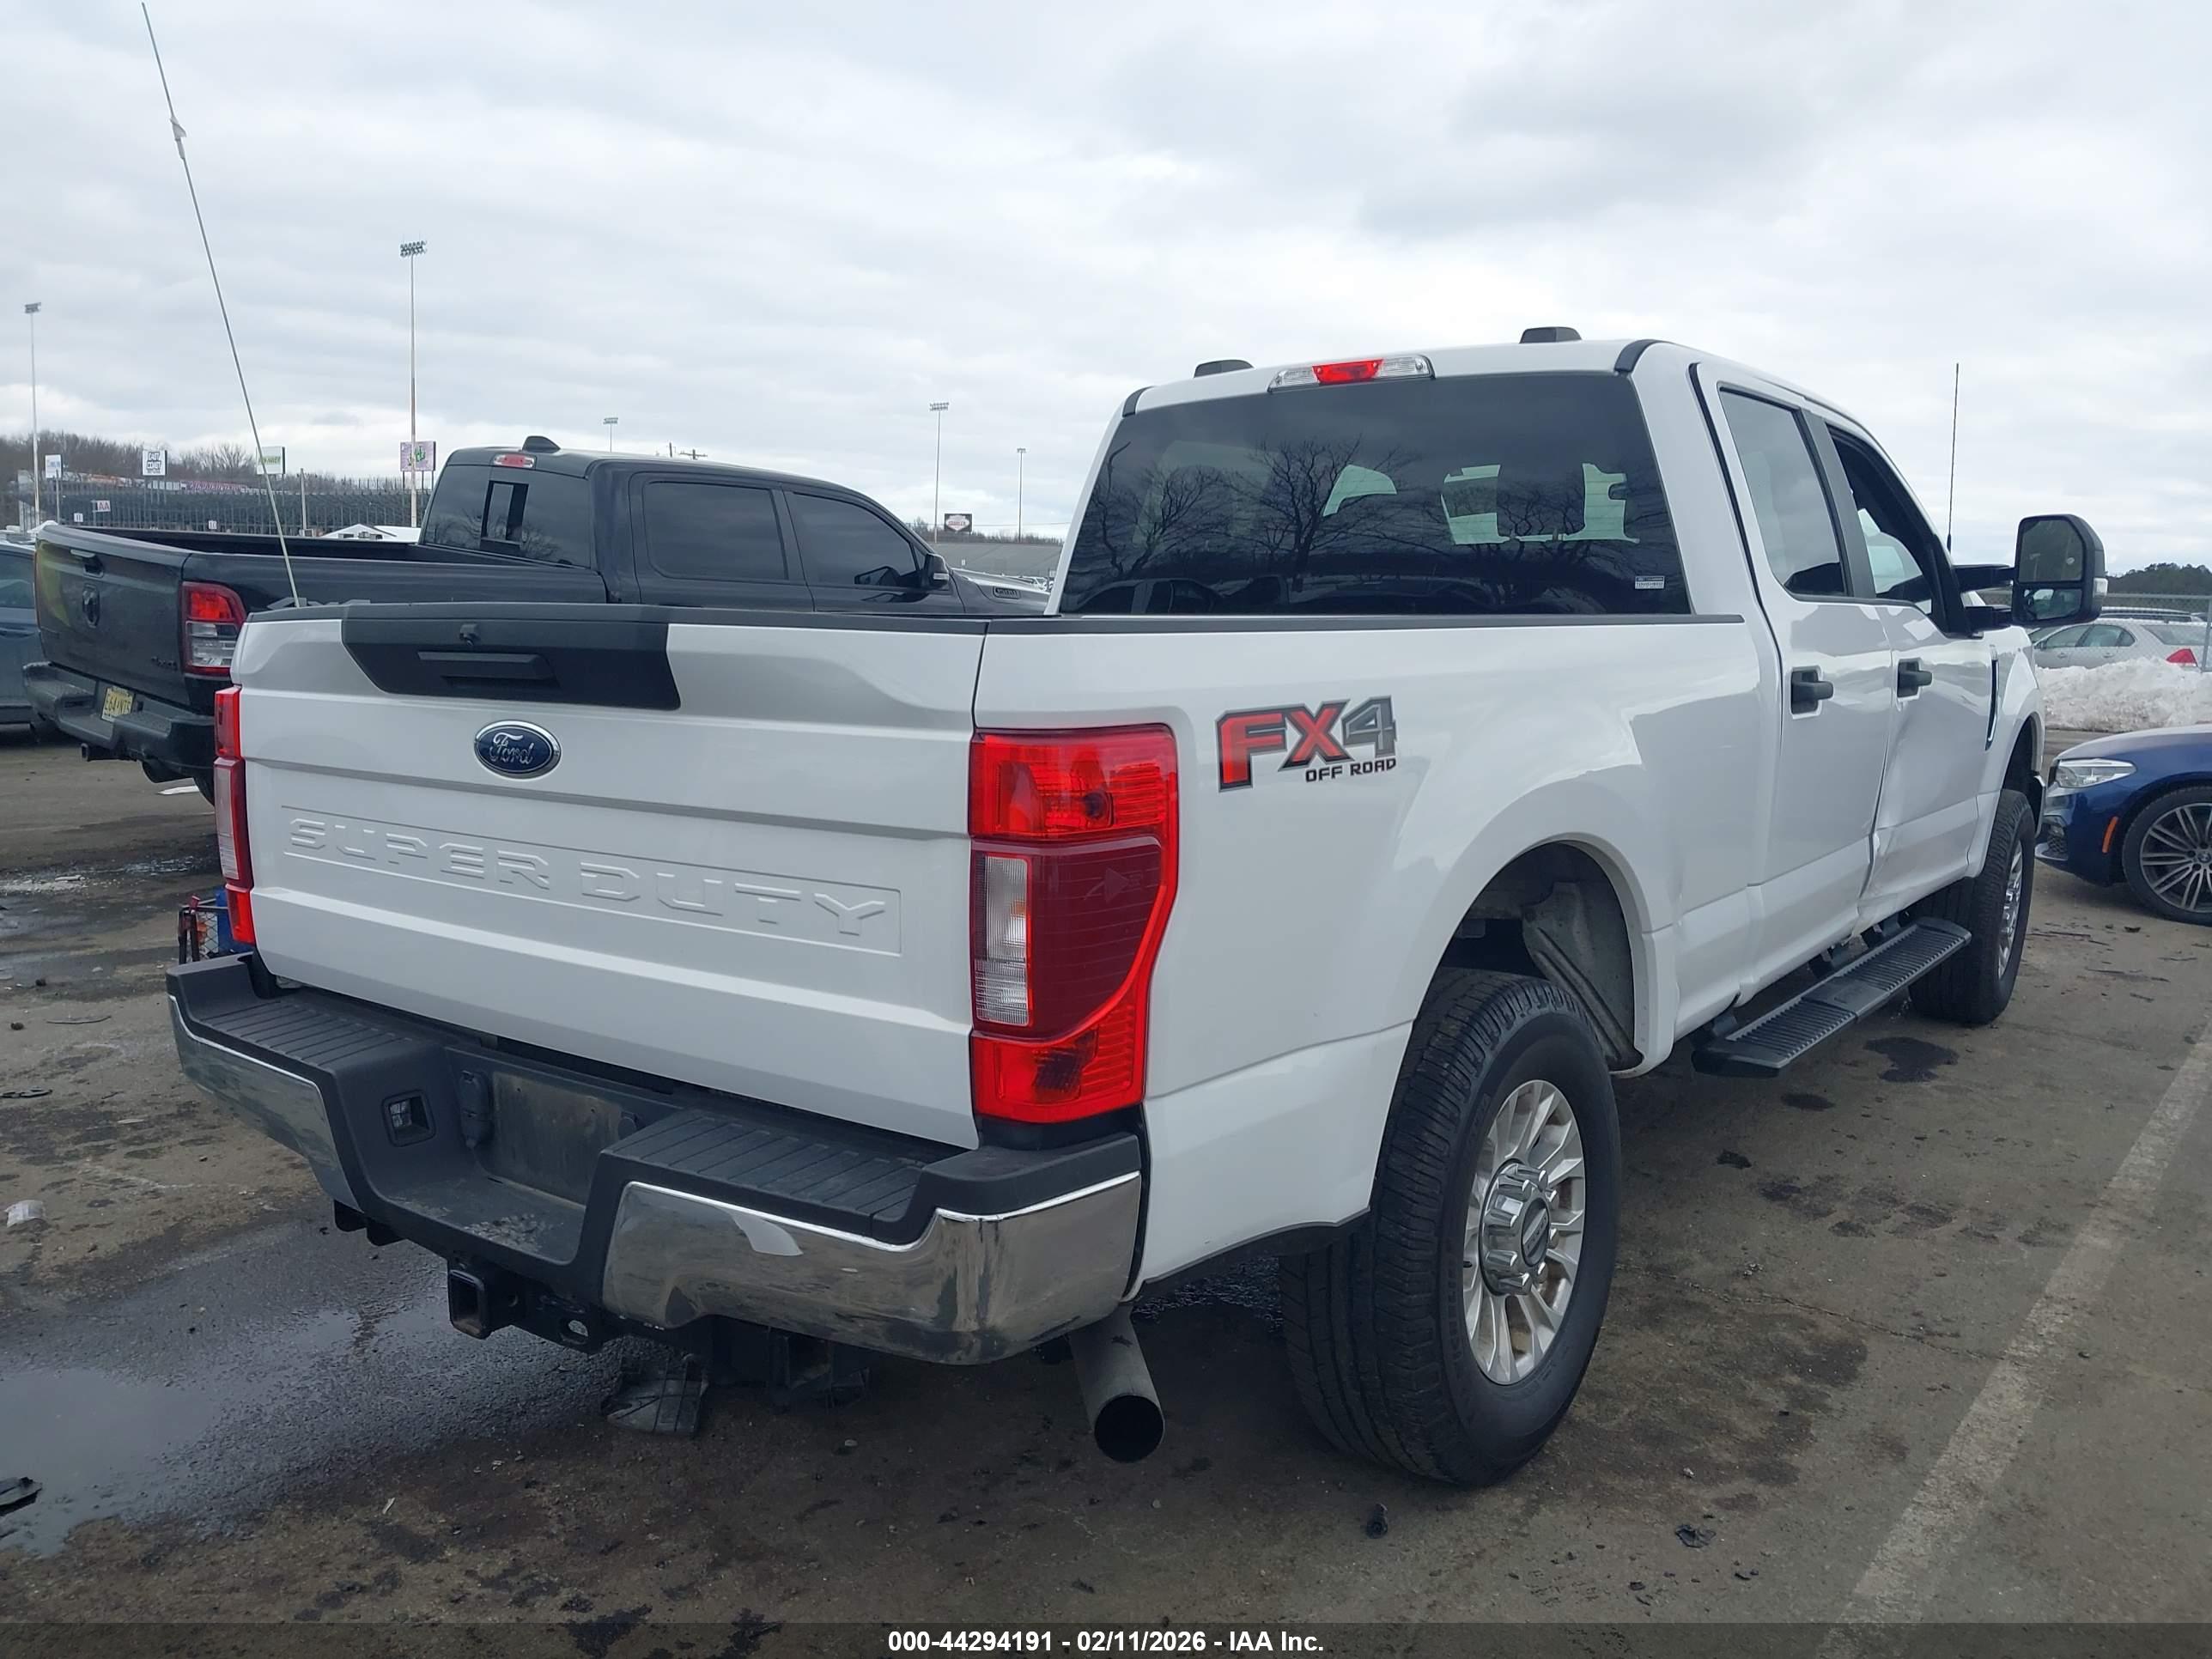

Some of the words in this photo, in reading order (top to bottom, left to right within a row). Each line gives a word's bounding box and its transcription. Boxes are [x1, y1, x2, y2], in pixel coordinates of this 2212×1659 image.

[489, 732, 534, 765] Ford
[1215, 696, 1397, 793] FX4
[1305, 765, 1342, 782] OFF
[1350, 758, 1396, 776] ROAD
[290, 817, 550, 890] SUPER
[580, 861, 885, 936] DUTY
